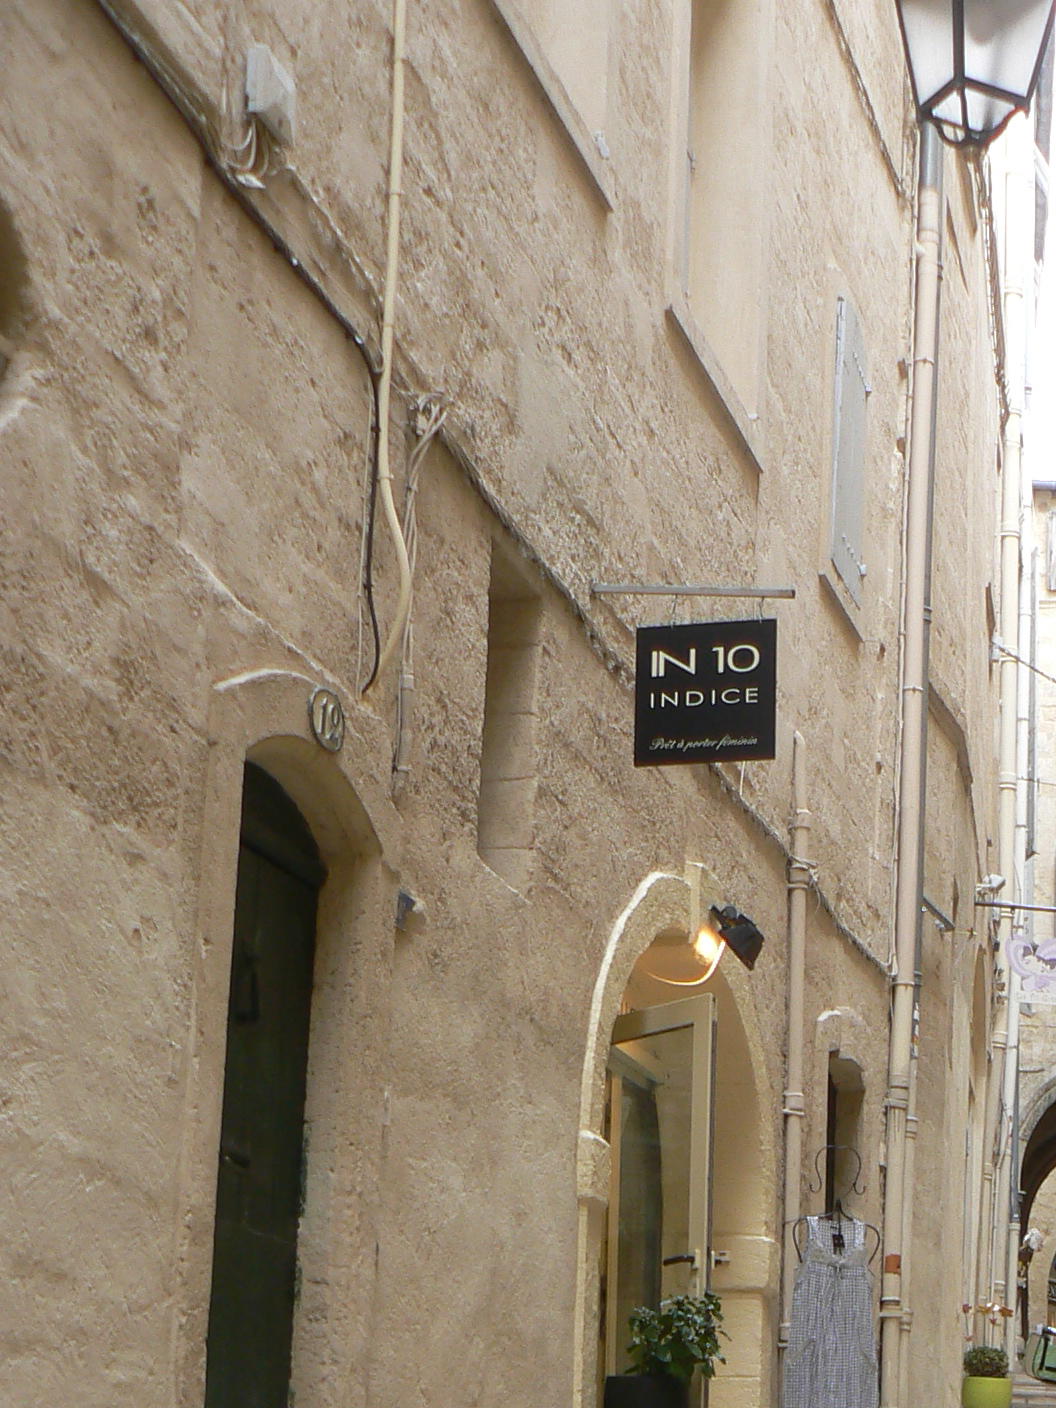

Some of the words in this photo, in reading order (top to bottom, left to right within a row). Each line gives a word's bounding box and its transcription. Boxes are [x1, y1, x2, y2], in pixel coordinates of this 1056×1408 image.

[651, 648, 697, 678] IN
[712, 644, 760, 674] 10
[650, 687, 759, 709] INDICE
[318, 697, 340, 740] 19
[682, 737, 718, 753] porter
